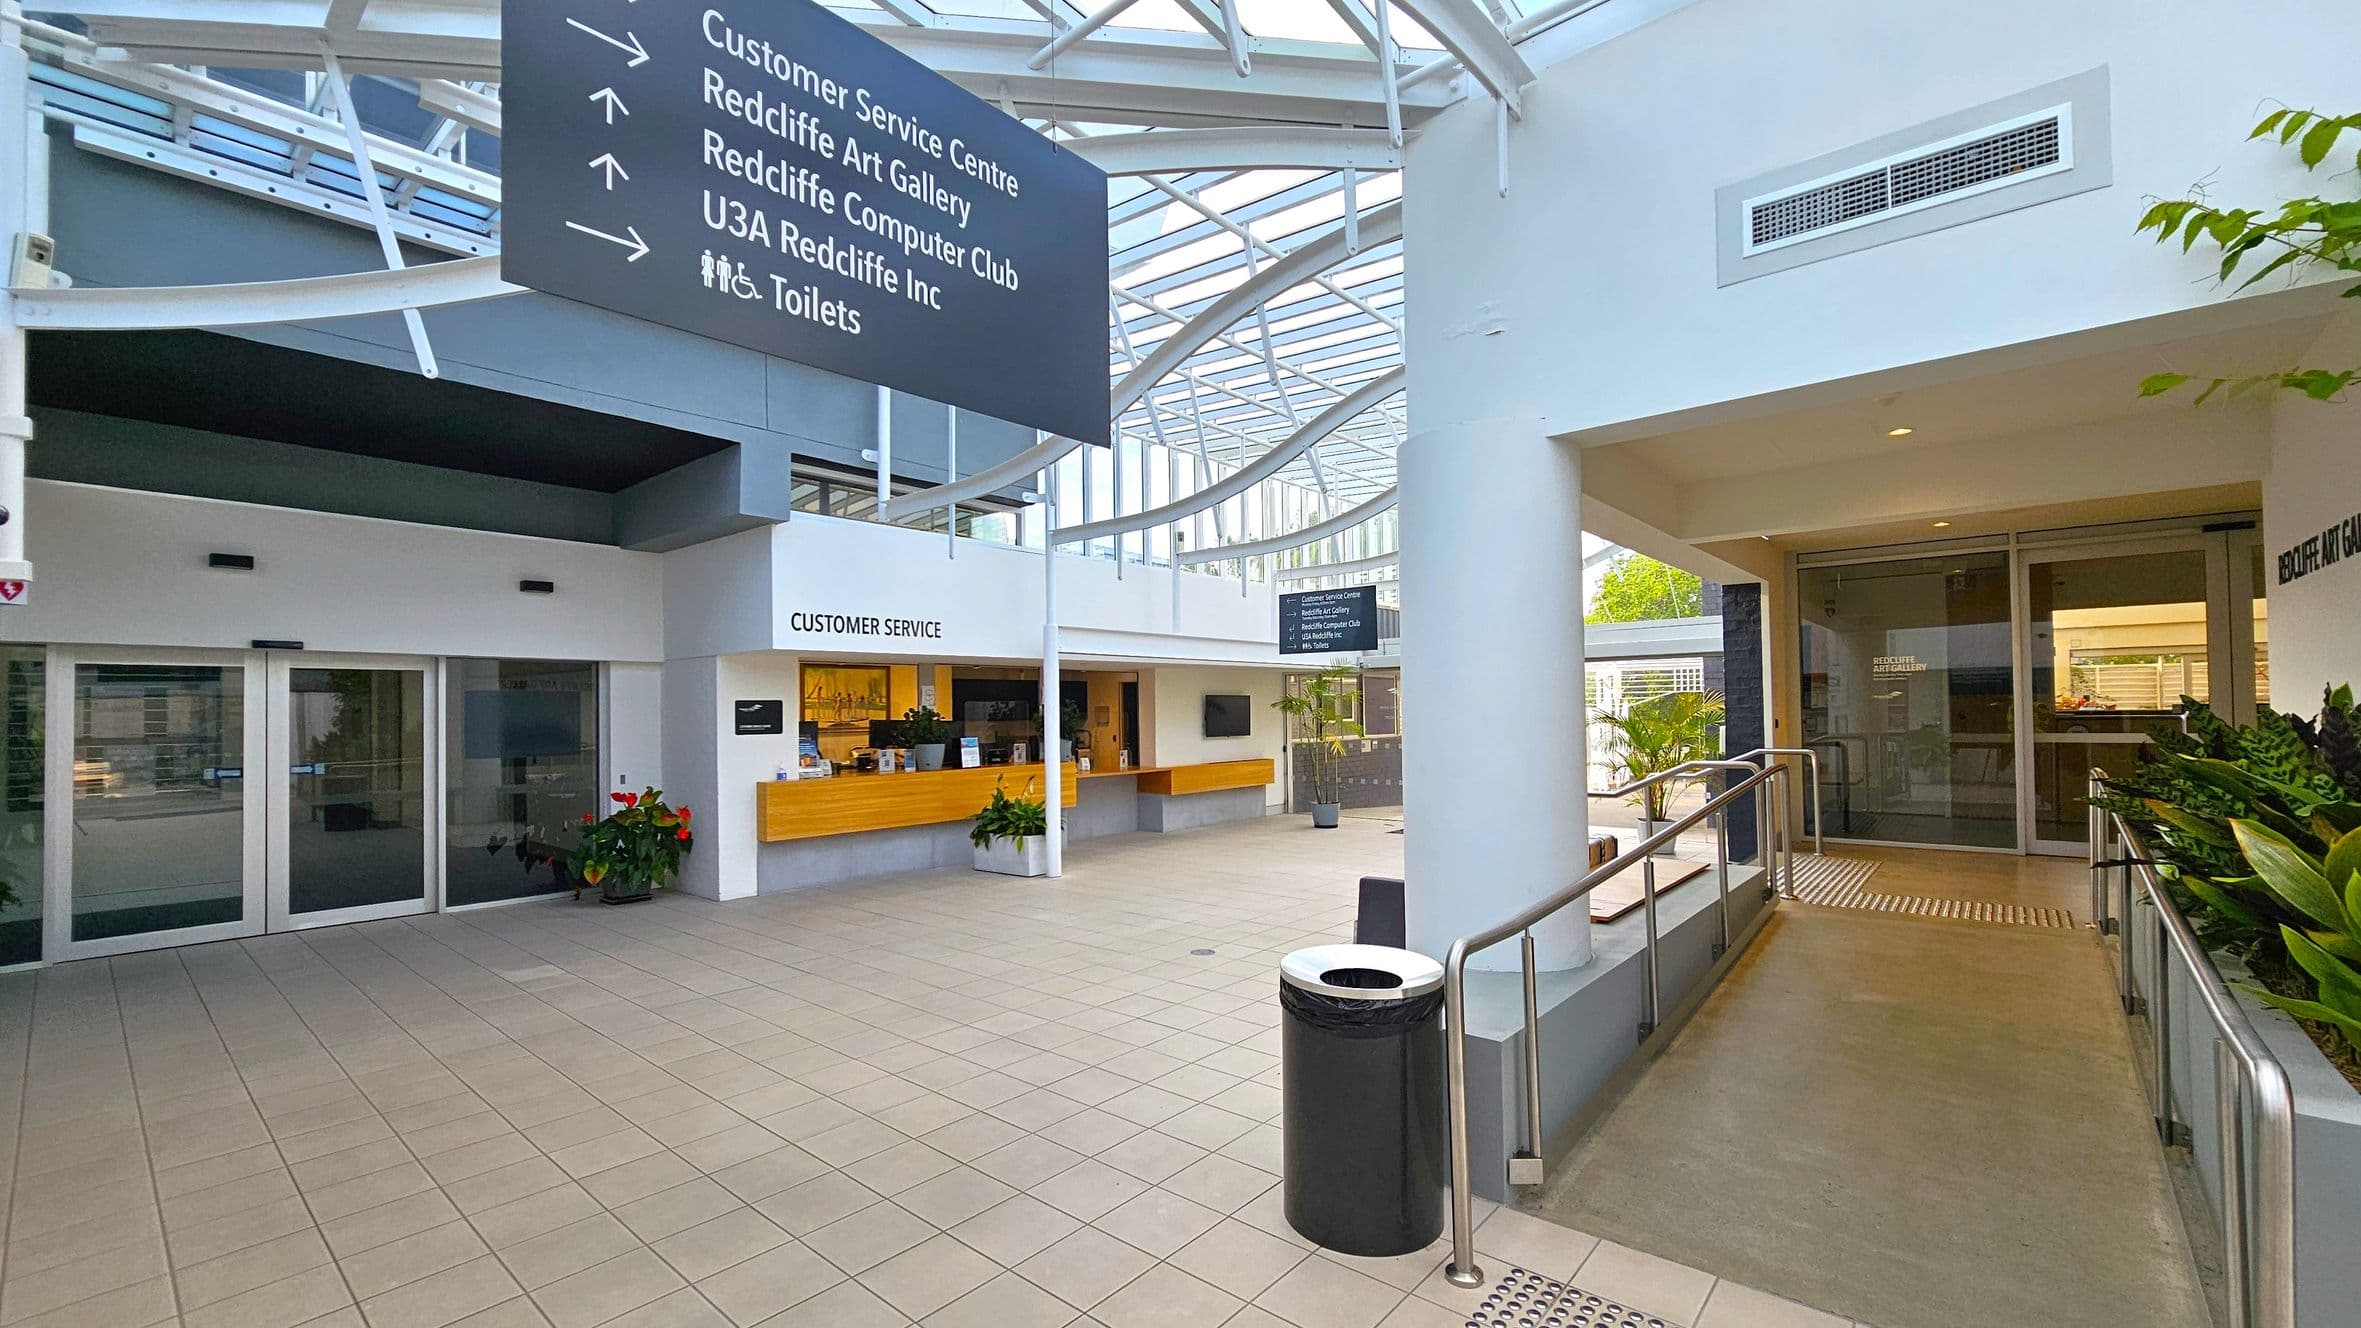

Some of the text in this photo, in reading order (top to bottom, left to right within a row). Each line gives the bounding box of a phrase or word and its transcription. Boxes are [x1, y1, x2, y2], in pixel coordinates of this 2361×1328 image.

[702, 8, 1019, 198] Customer Service Centre
[703, 66, 971, 229] Redcliffe Art Gallery
[703, 128, 1019, 291] Redcliffe Computer Club
[703, 189, 942, 310] U3A Redcliffe Inc
[769, 273, 861, 335] Toilets
[2321, 524, 2340, 568] ART
[790, 612, 942, 639] CUSTOMER SERVICE
[1301, 608, 1322, 616] Redcliffe
[1331, 607, 1350, 615] Gallery
[1301, 622, 1323, 630] Redcliffe
[1323, 621, 1347, 629] Computer
[1312, 631, 1334, 640] Redcliffe
[1873, 656, 1917, 665] REDCLIFFE
[1873, 663, 1928, 673] ART GALLERY
